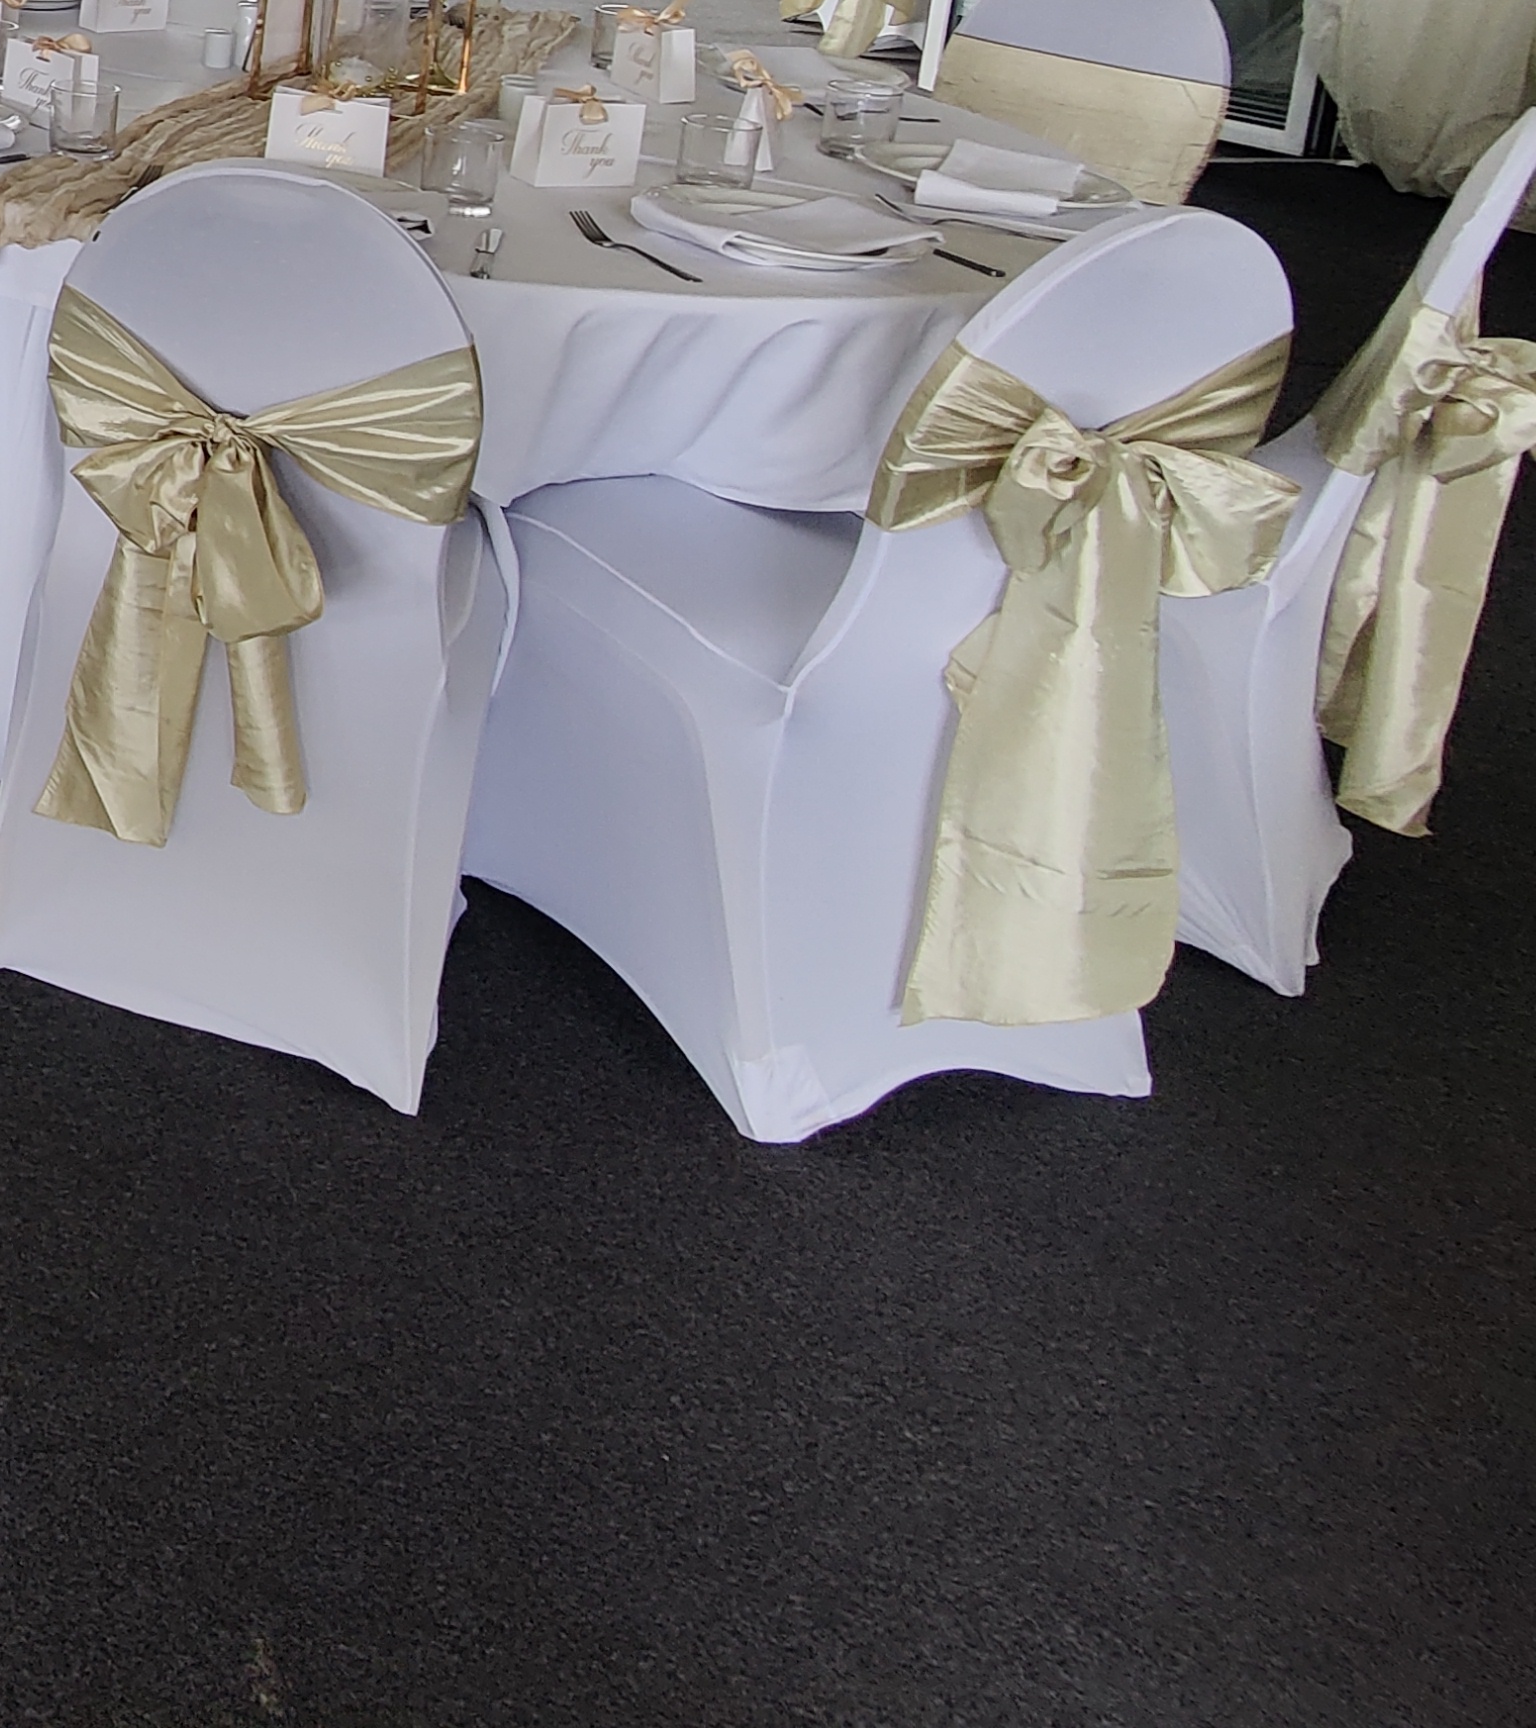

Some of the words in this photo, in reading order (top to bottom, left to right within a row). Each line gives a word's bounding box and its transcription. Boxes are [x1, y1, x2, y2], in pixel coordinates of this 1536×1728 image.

[18, 67, 56, 95] Thank
[561, 128, 614, 156] Thank
[582, 157, 616, 180] you
